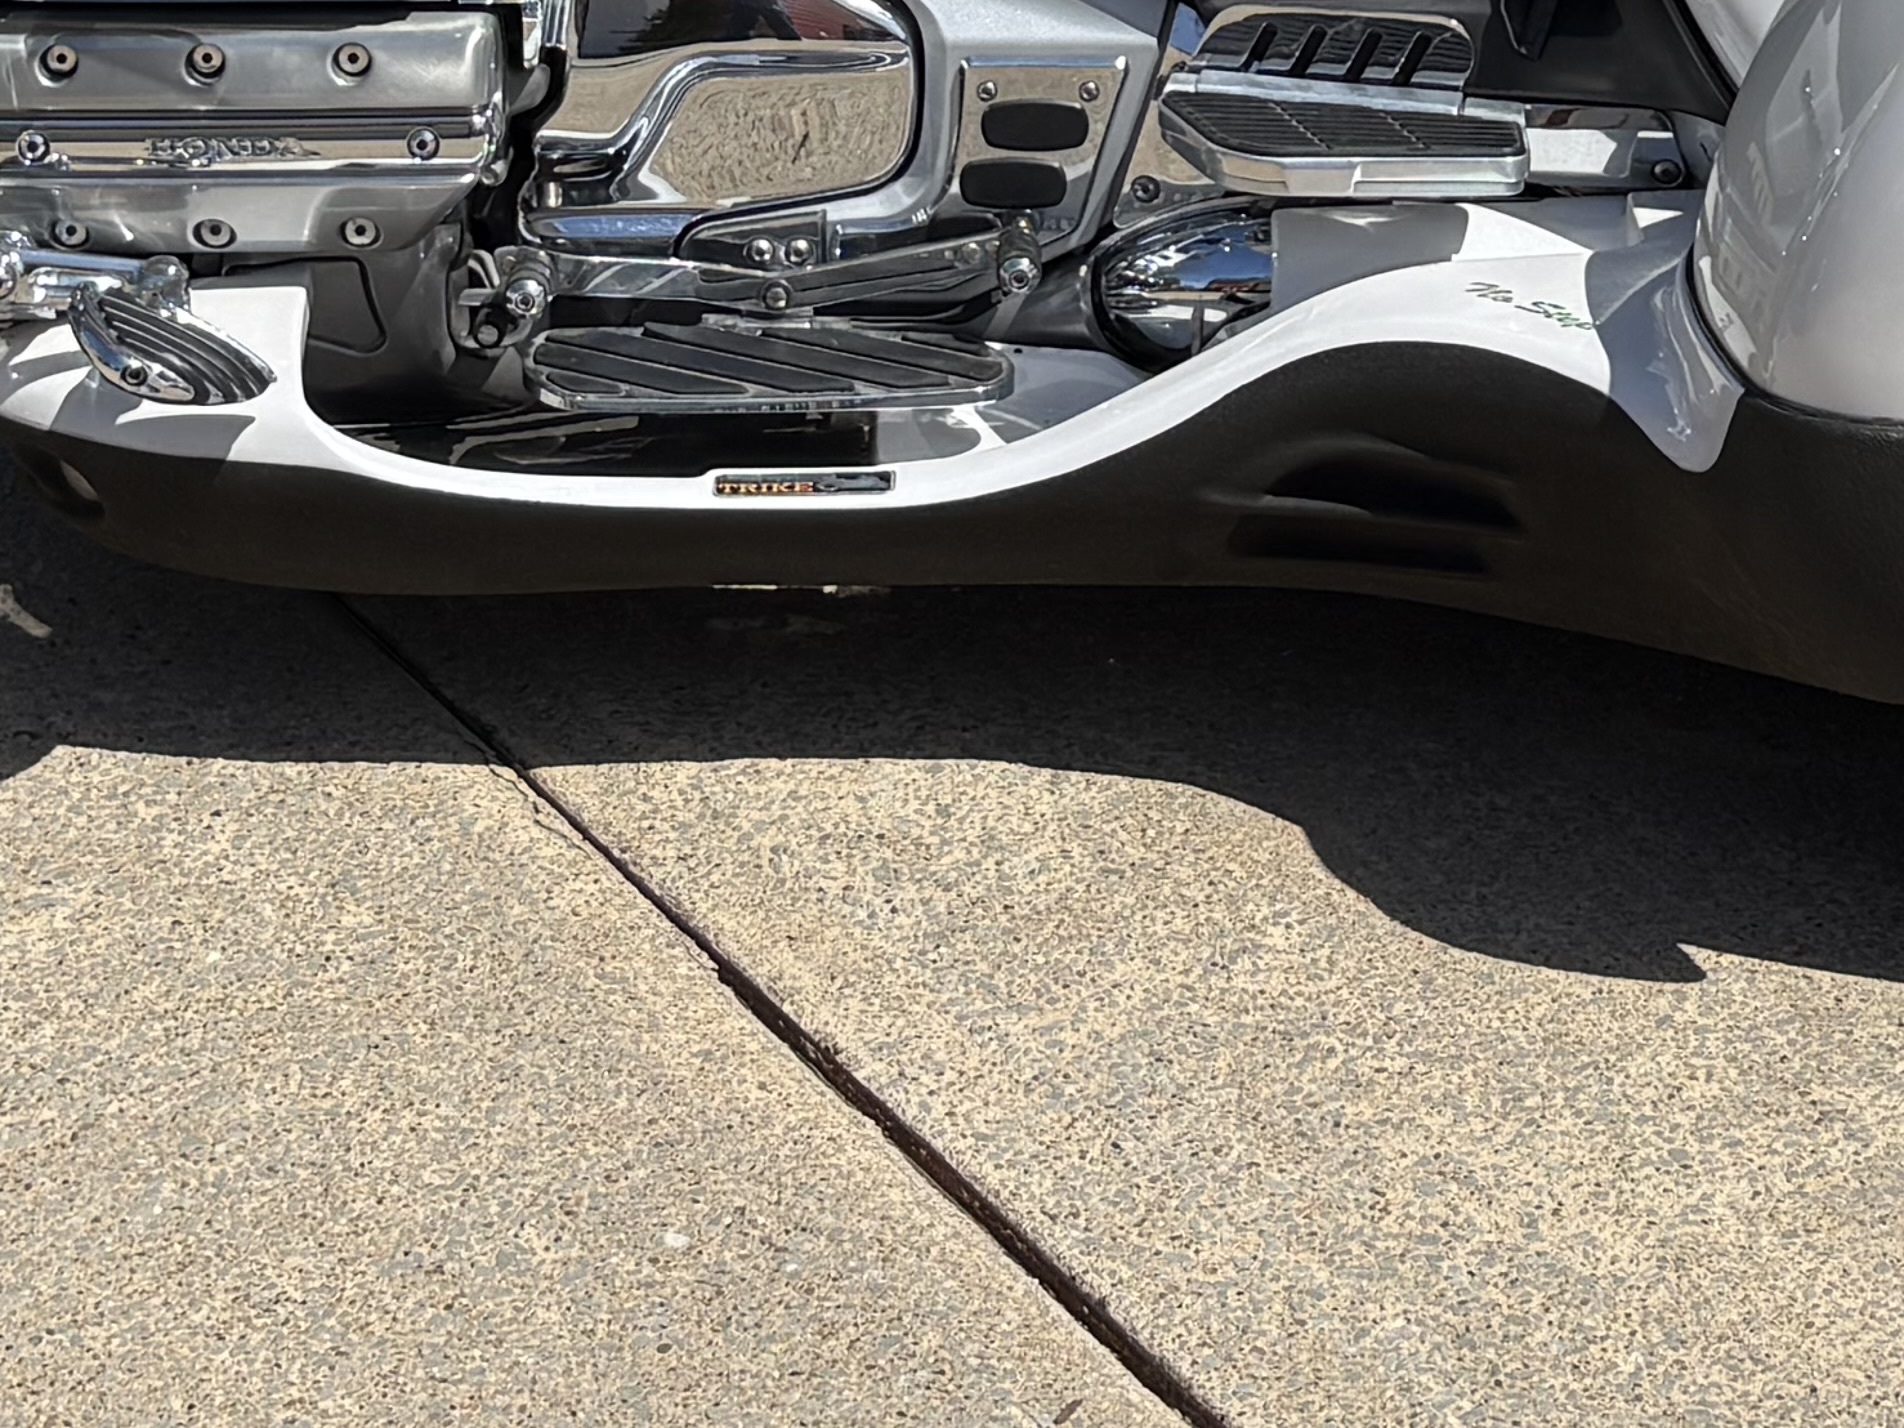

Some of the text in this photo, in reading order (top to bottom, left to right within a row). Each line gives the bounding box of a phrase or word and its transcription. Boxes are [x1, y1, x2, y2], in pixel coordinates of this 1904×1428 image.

[144, 135, 321, 159] HONDA
[1464, 281, 1514, 304] No
[717, 480, 815, 494] TRIKE
